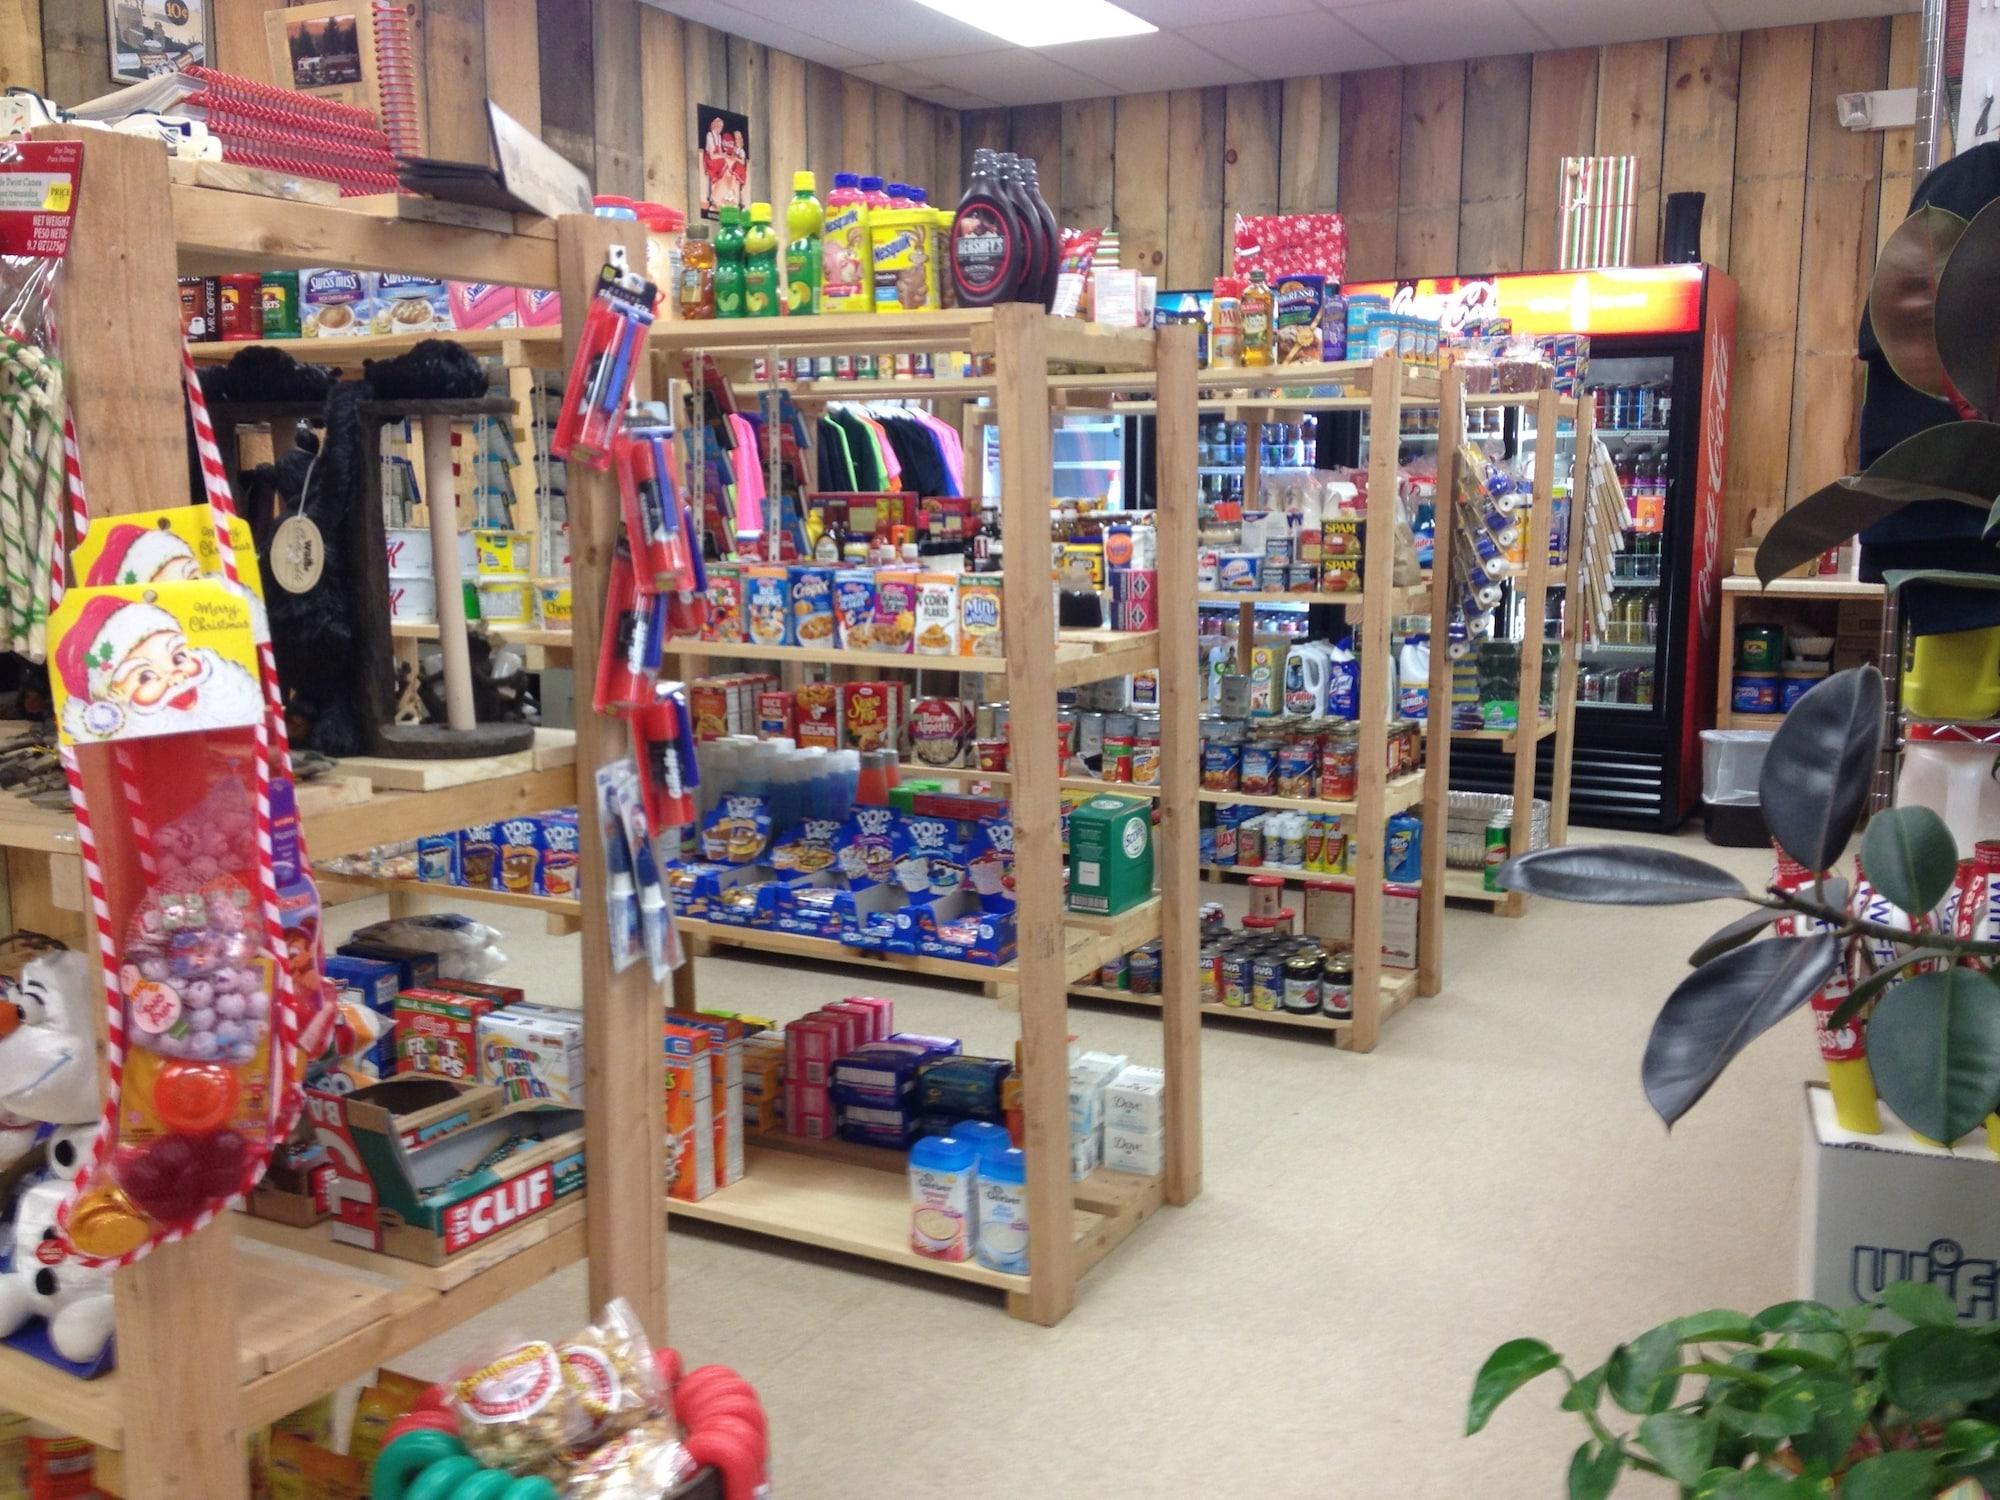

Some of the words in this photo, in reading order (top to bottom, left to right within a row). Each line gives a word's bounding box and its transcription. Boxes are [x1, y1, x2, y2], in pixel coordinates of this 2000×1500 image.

[873, 233, 911, 261] Nesquik
[1699, 315, 1730, 638] Coca-Cola
[1325, 523, 1357, 534] SPAM
[1325, 559, 1357, 571] SPAM
[923, 594, 949, 605] CORN
[194, 602, 239, 619] Merry
[923, 606, 949, 618] FLAKES
[189, 615, 249, 633] Christmas
[1112, 1095, 1142, 1109] Dove
[1112, 1135, 1142, 1150] Dove
[469, 1167, 549, 1235] CLIF
